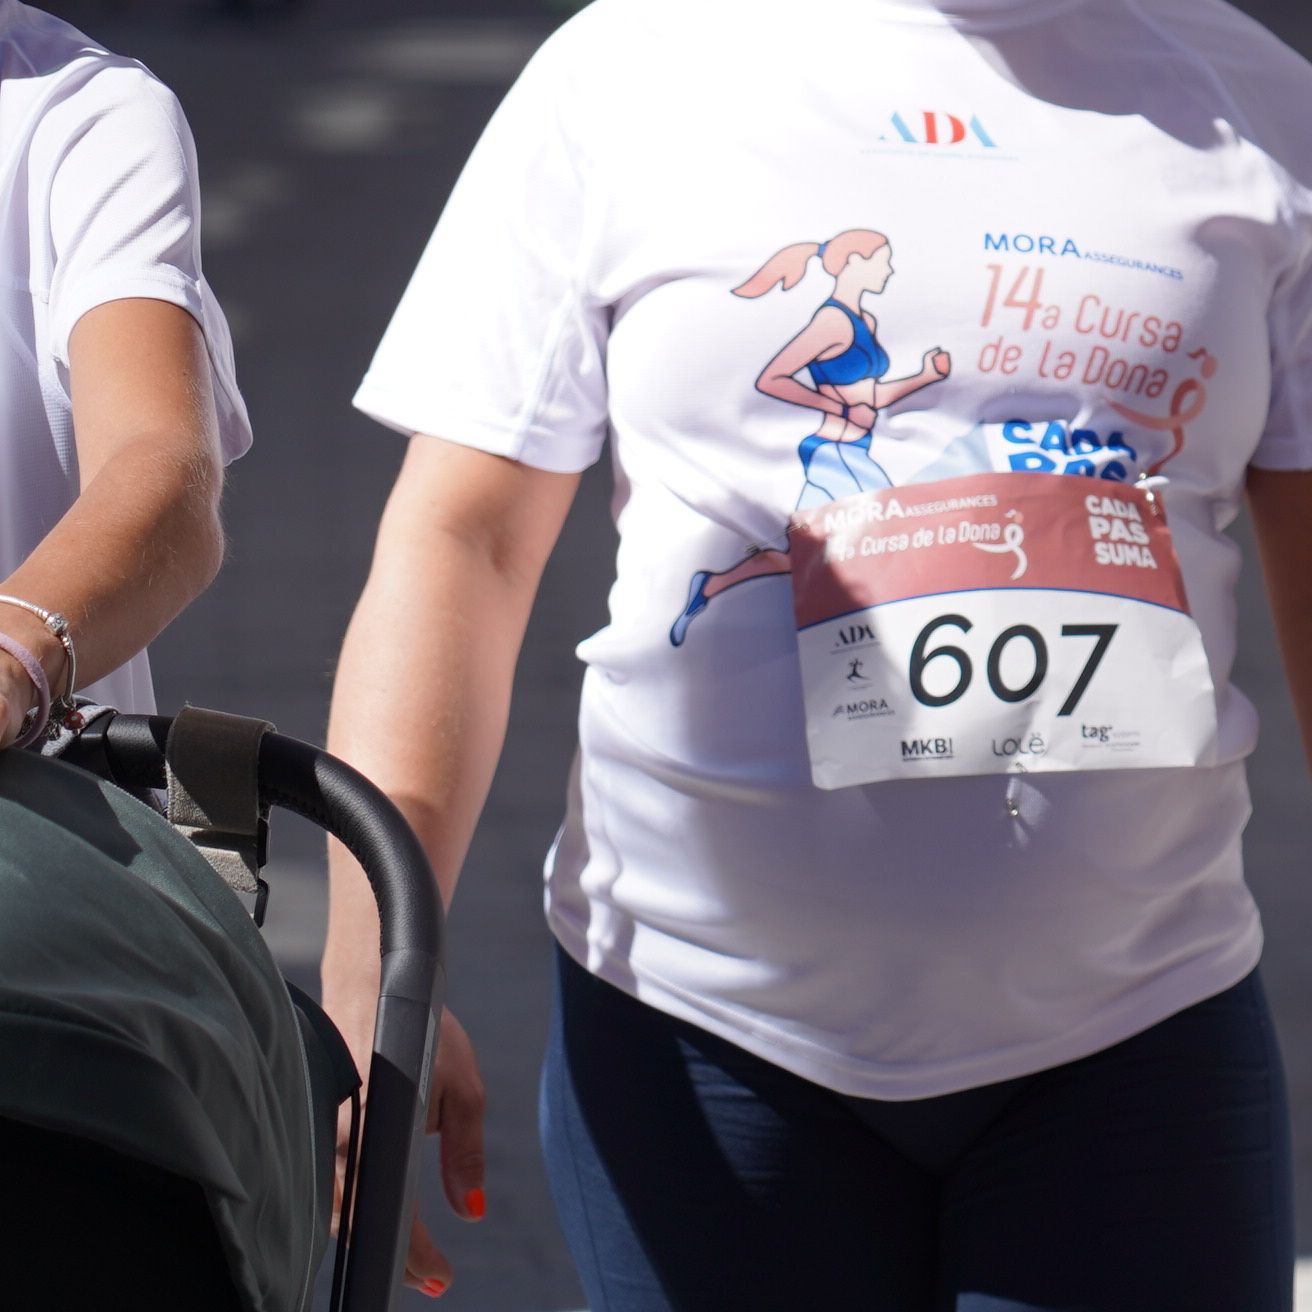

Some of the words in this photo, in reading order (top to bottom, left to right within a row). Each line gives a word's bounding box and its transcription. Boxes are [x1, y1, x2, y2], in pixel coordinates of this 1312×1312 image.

[877, 110, 998, 149] ADA
[984, 233, 1081, 259] MORA
[1074, 294, 1183, 354] Cursa
[977, 337, 1023, 375] de
[1037, 340, 1077, 380] la
[1082, 346, 1169, 399] Dona
[905, 494, 998, 517] ASSEGURANCES
[1085, 494, 1142, 523] CADA
[861, 535, 908, 557] Cursa
[912, 526, 934, 548] de
[938, 524, 957, 545] la
[958, 520, 1001, 543] Dona
[1089, 515, 1150, 545] PAS
[1094, 541, 1158, 569] SUMA
[909, 614, 1119, 718] 607
[847, 699, 889, 714] MORA
